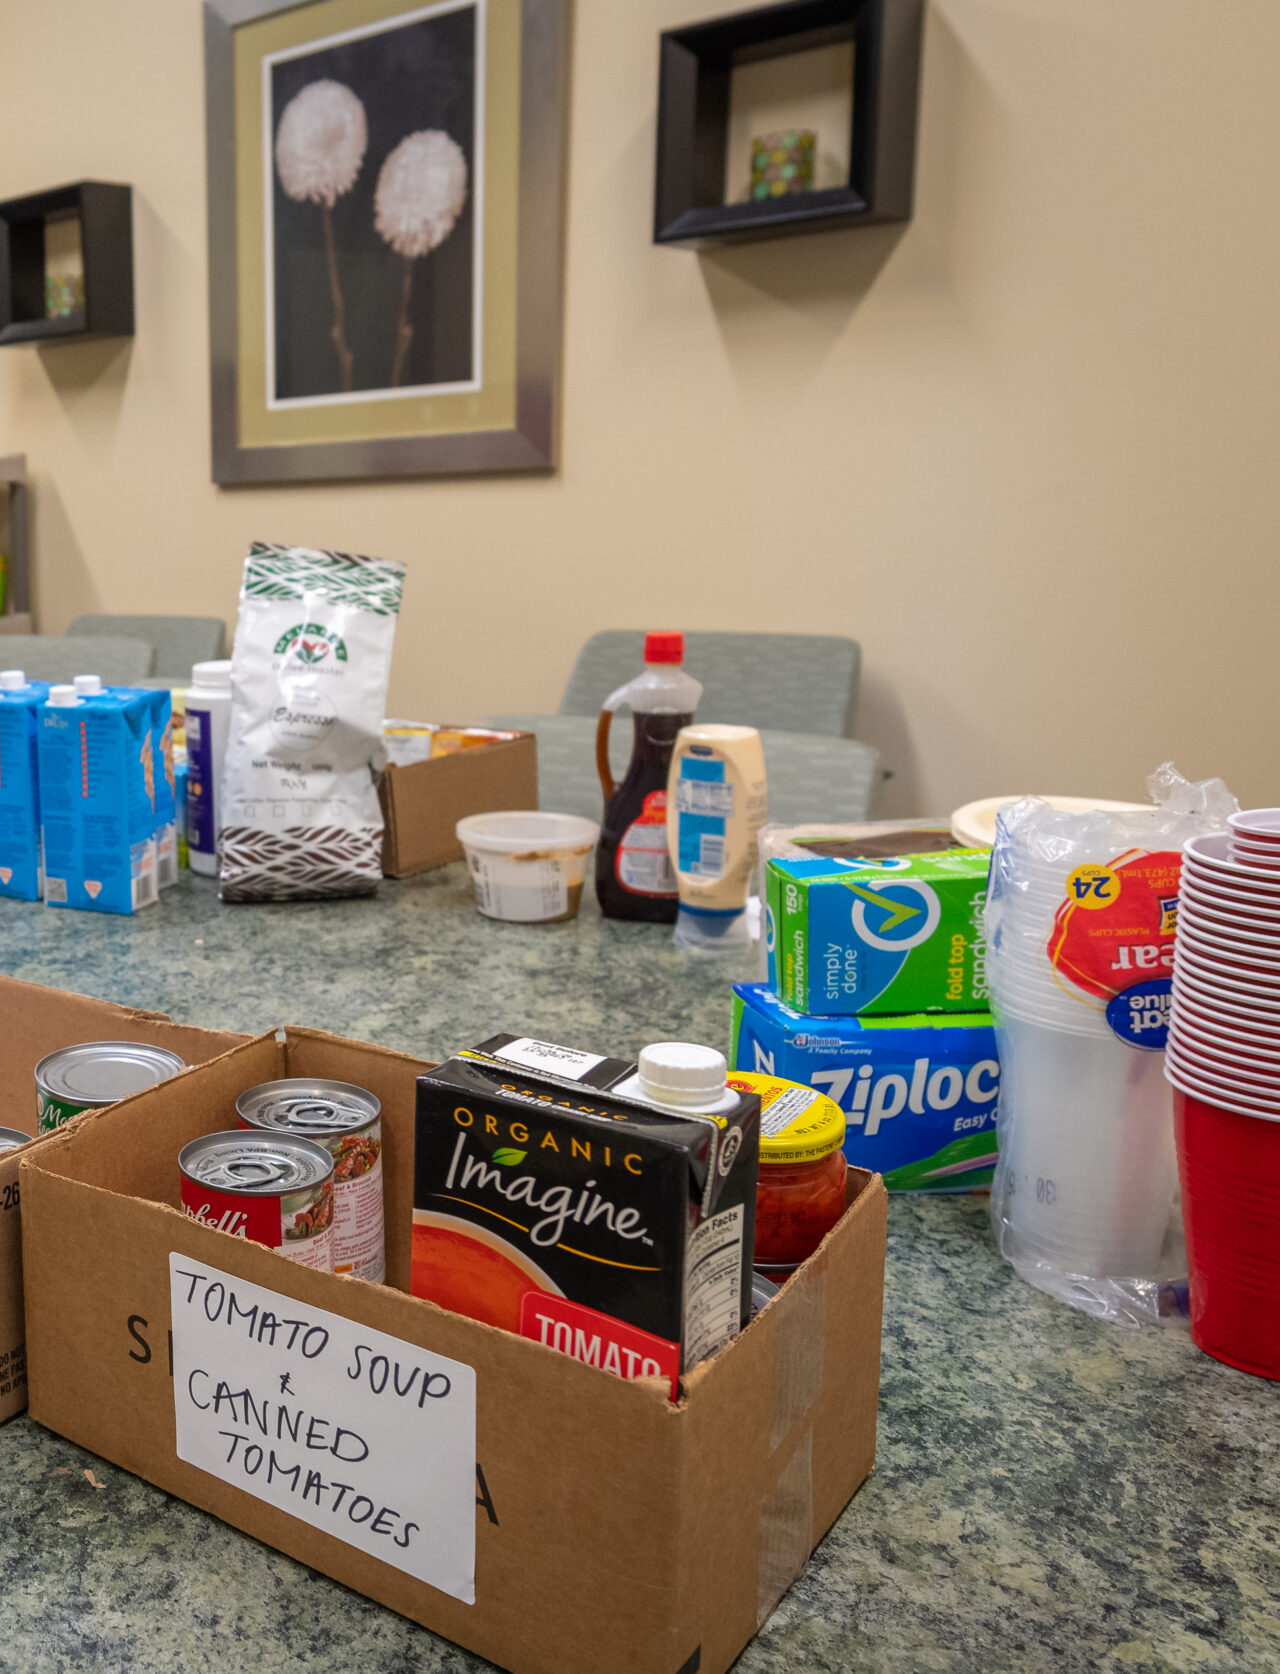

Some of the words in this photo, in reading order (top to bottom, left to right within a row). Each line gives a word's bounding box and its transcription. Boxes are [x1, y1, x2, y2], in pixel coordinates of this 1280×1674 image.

[252, 760, 268, 769] Net
[785, 884, 798, 915] 150
[1072, 876, 1111, 899] 24
[1148, 879, 1176, 889] CUPS
[948, 934, 968, 965] top
[969, 891, 990, 1000] sandwich
[1088, 928, 1112, 937] CUPS
[794, 930, 804, 1006] sandwich
[824, 942, 843, 1000] simply
[841, 949, 858, 994] done
[1111, 944, 1177, 970] ear
[946, 966, 964, 1001] fold
[495, 1089, 552, 1107] TOMATO
[761, 1086, 783, 1108] ENTOS
[810, 1058, 1001, 1136] Ziploc
[953, 1114, 984, 1132] Easy
[454, 1107, 642, 1175] ORGANIC
[445, 1131, 648, 1247] Imagine
[711, 1211, 738, 1230] Facts
[176, 1270, 329, 1358] TOMATO
[347, 1344, 451, 1409] SOUP
[535, 1313, 661, 1381] TOMATO
[188, 1369, 369, 1463] CANNED
[219, 1431, 420, 1549] TOMATOES
